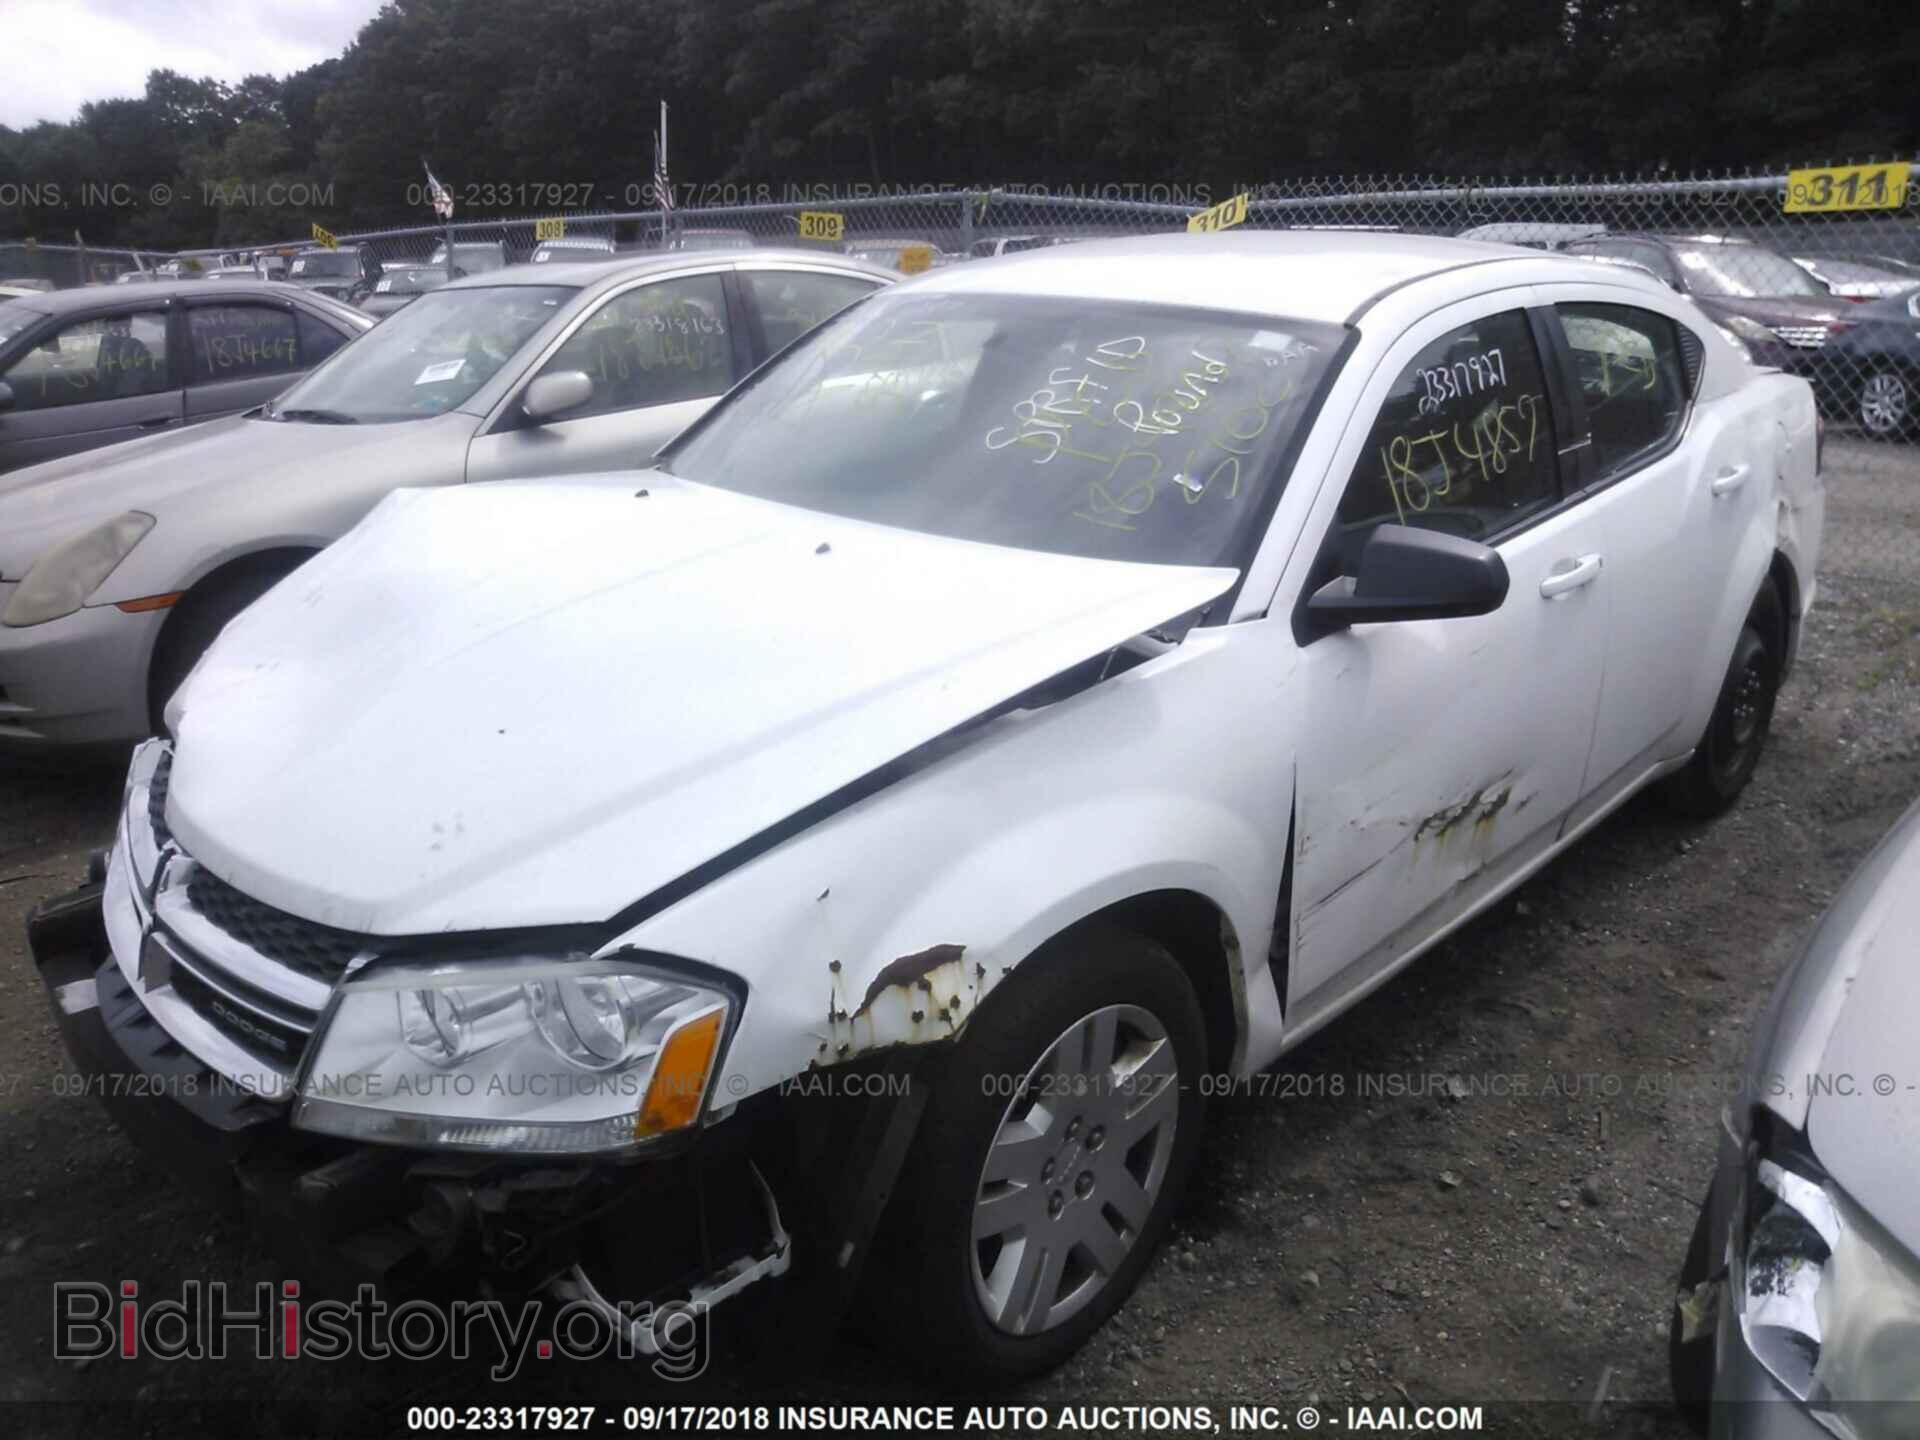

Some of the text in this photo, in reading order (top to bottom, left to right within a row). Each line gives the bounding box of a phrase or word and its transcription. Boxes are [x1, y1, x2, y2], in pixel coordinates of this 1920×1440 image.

[1808, 169, 1888, 206] 311
[539, 221, 561, 238] 308
[805, 215, 838, 238] 309
[1197, 202, 1237, 232] 310
[1416, 349, 1507, 416] 23317927
[1379, 394, 1545, 526] 18J4859
